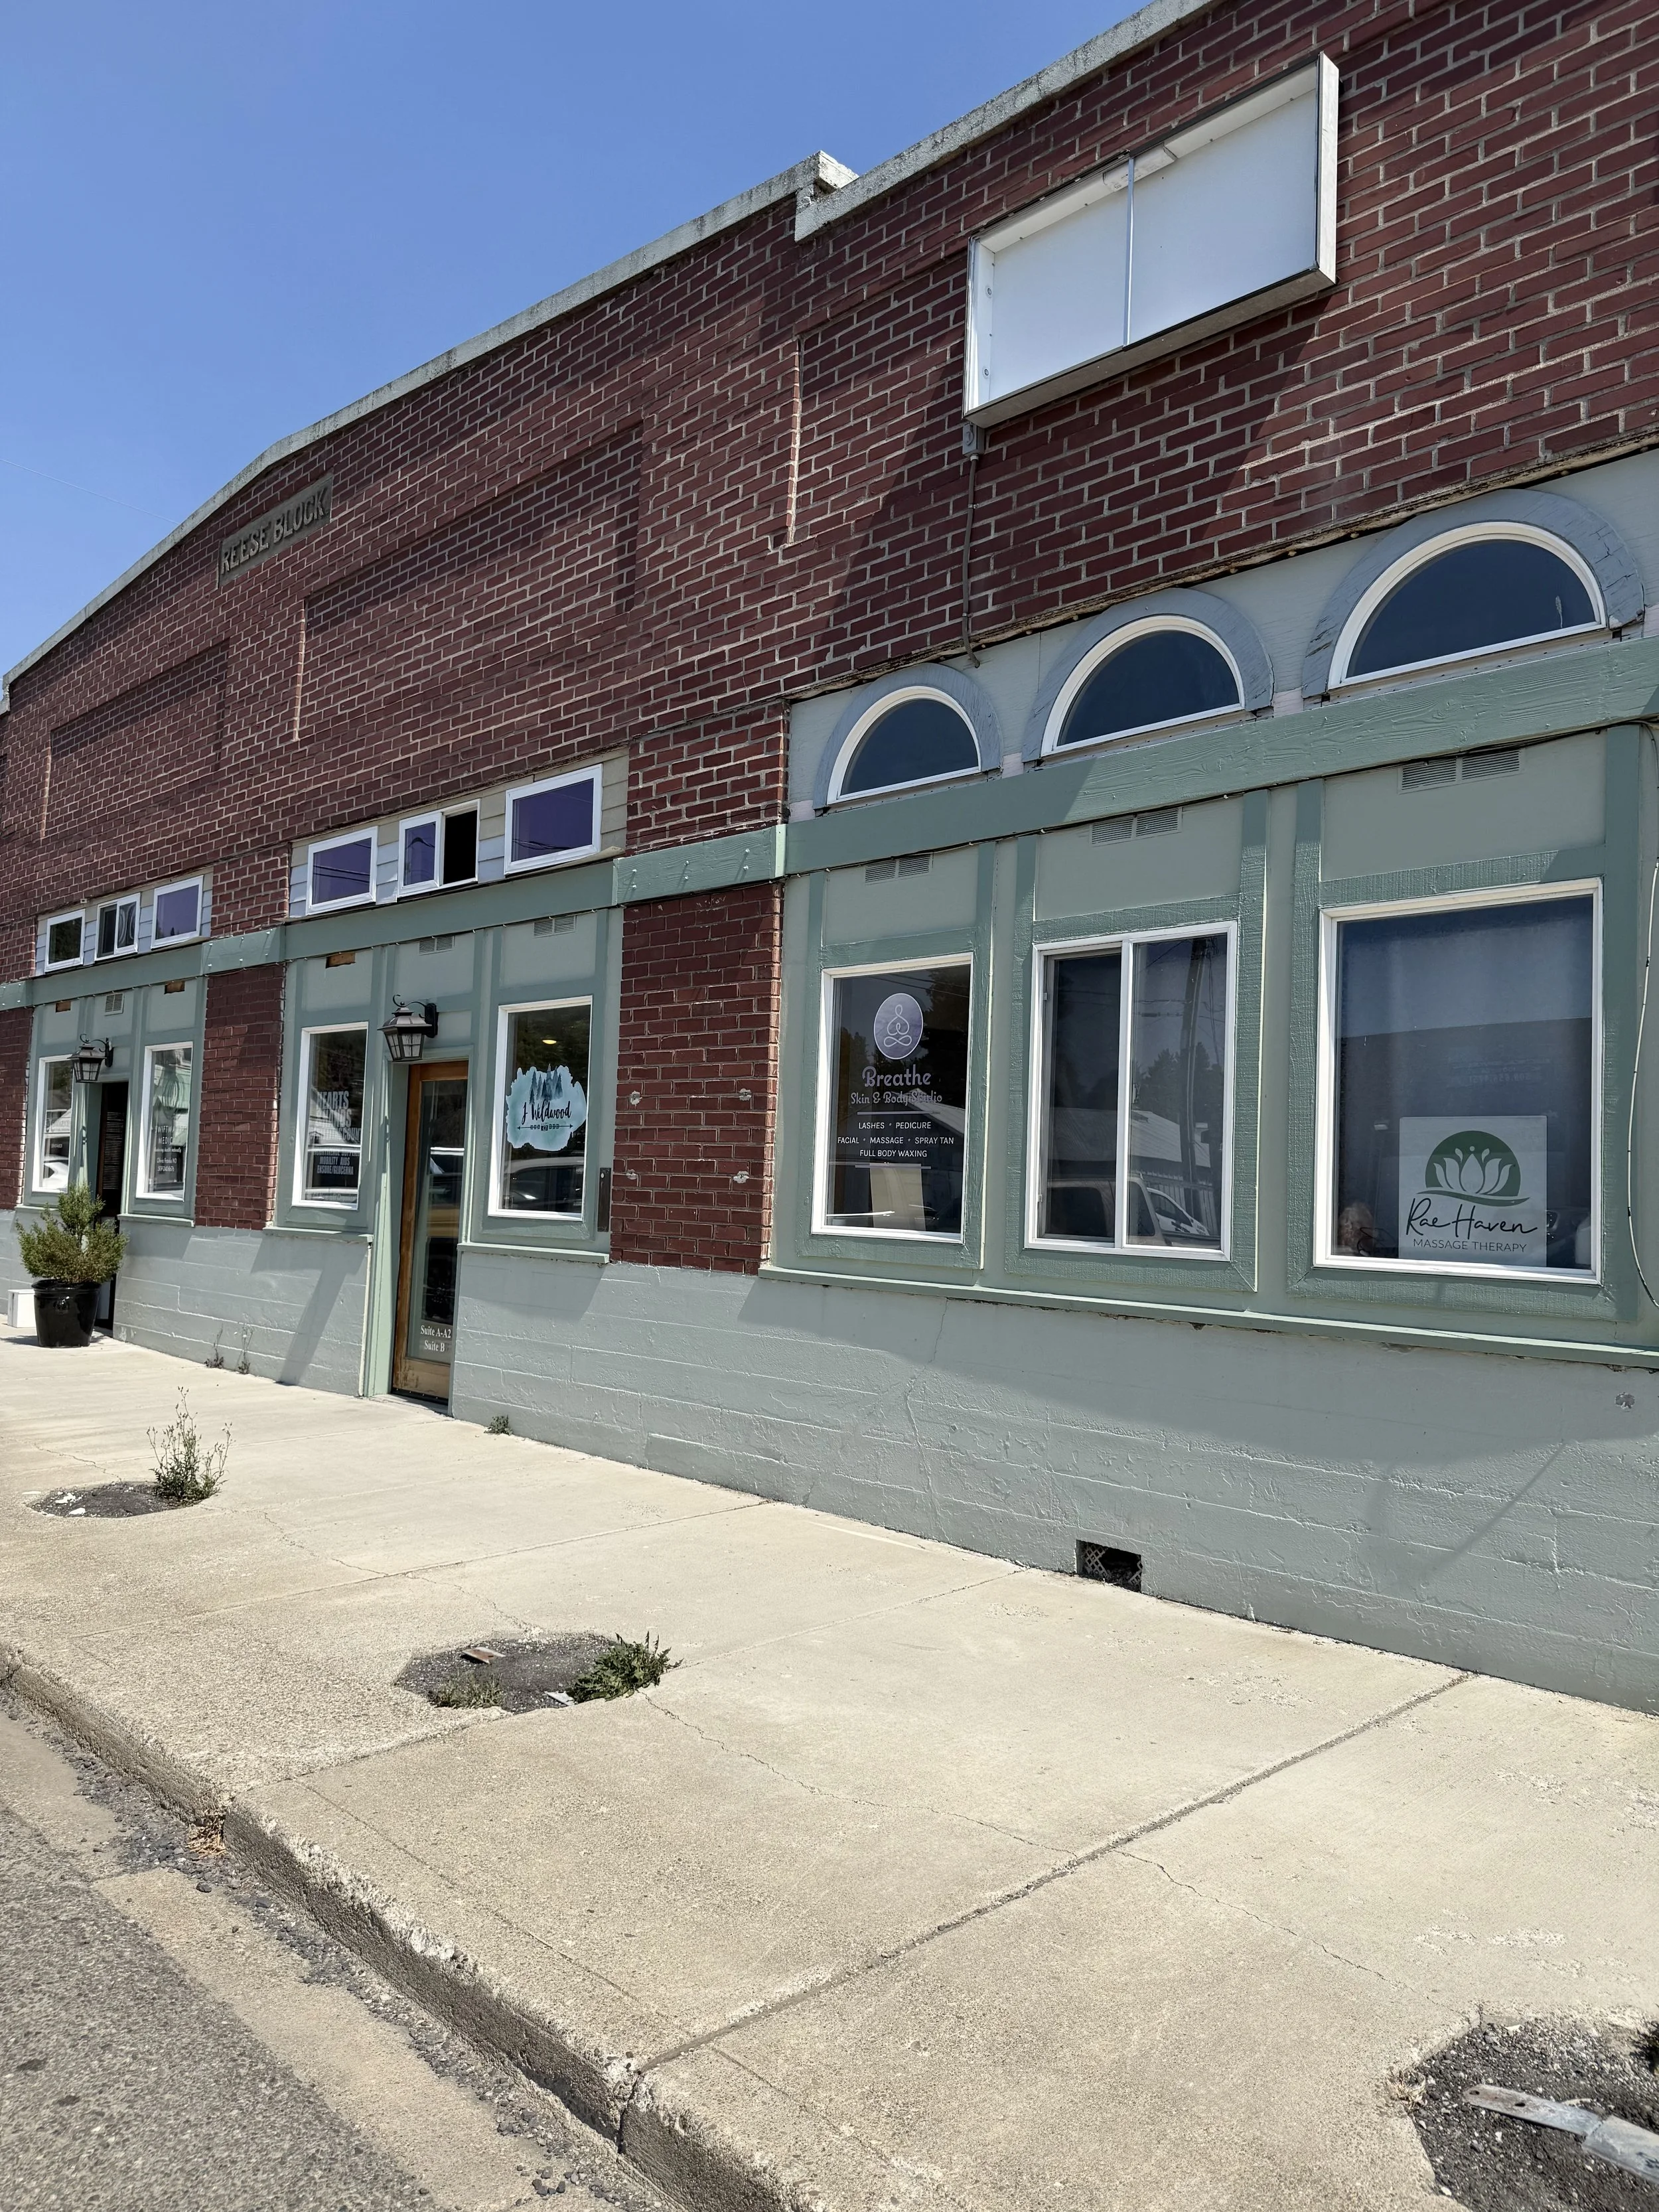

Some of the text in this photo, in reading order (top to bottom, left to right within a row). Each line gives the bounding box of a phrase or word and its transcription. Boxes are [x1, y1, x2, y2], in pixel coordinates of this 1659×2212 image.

[220, 486, 328, 575] REESE BLOCK
[862, 1064, 932, 1087] Breathe
[317, 1090, 349, 1110] HEARTS
[851, 1090, 942, 1106] Skin & Body Studio
[531, 1098, 572, 1122] Wildwood
[895, 1121, 932, 1130] PEDICURE
[1413, 1238, 1527, 1253] MASSAGE THERAPY
[420, 1325, 451, 1339] Suite A-A2
[424, 1339, 445, 1353] Suite B
